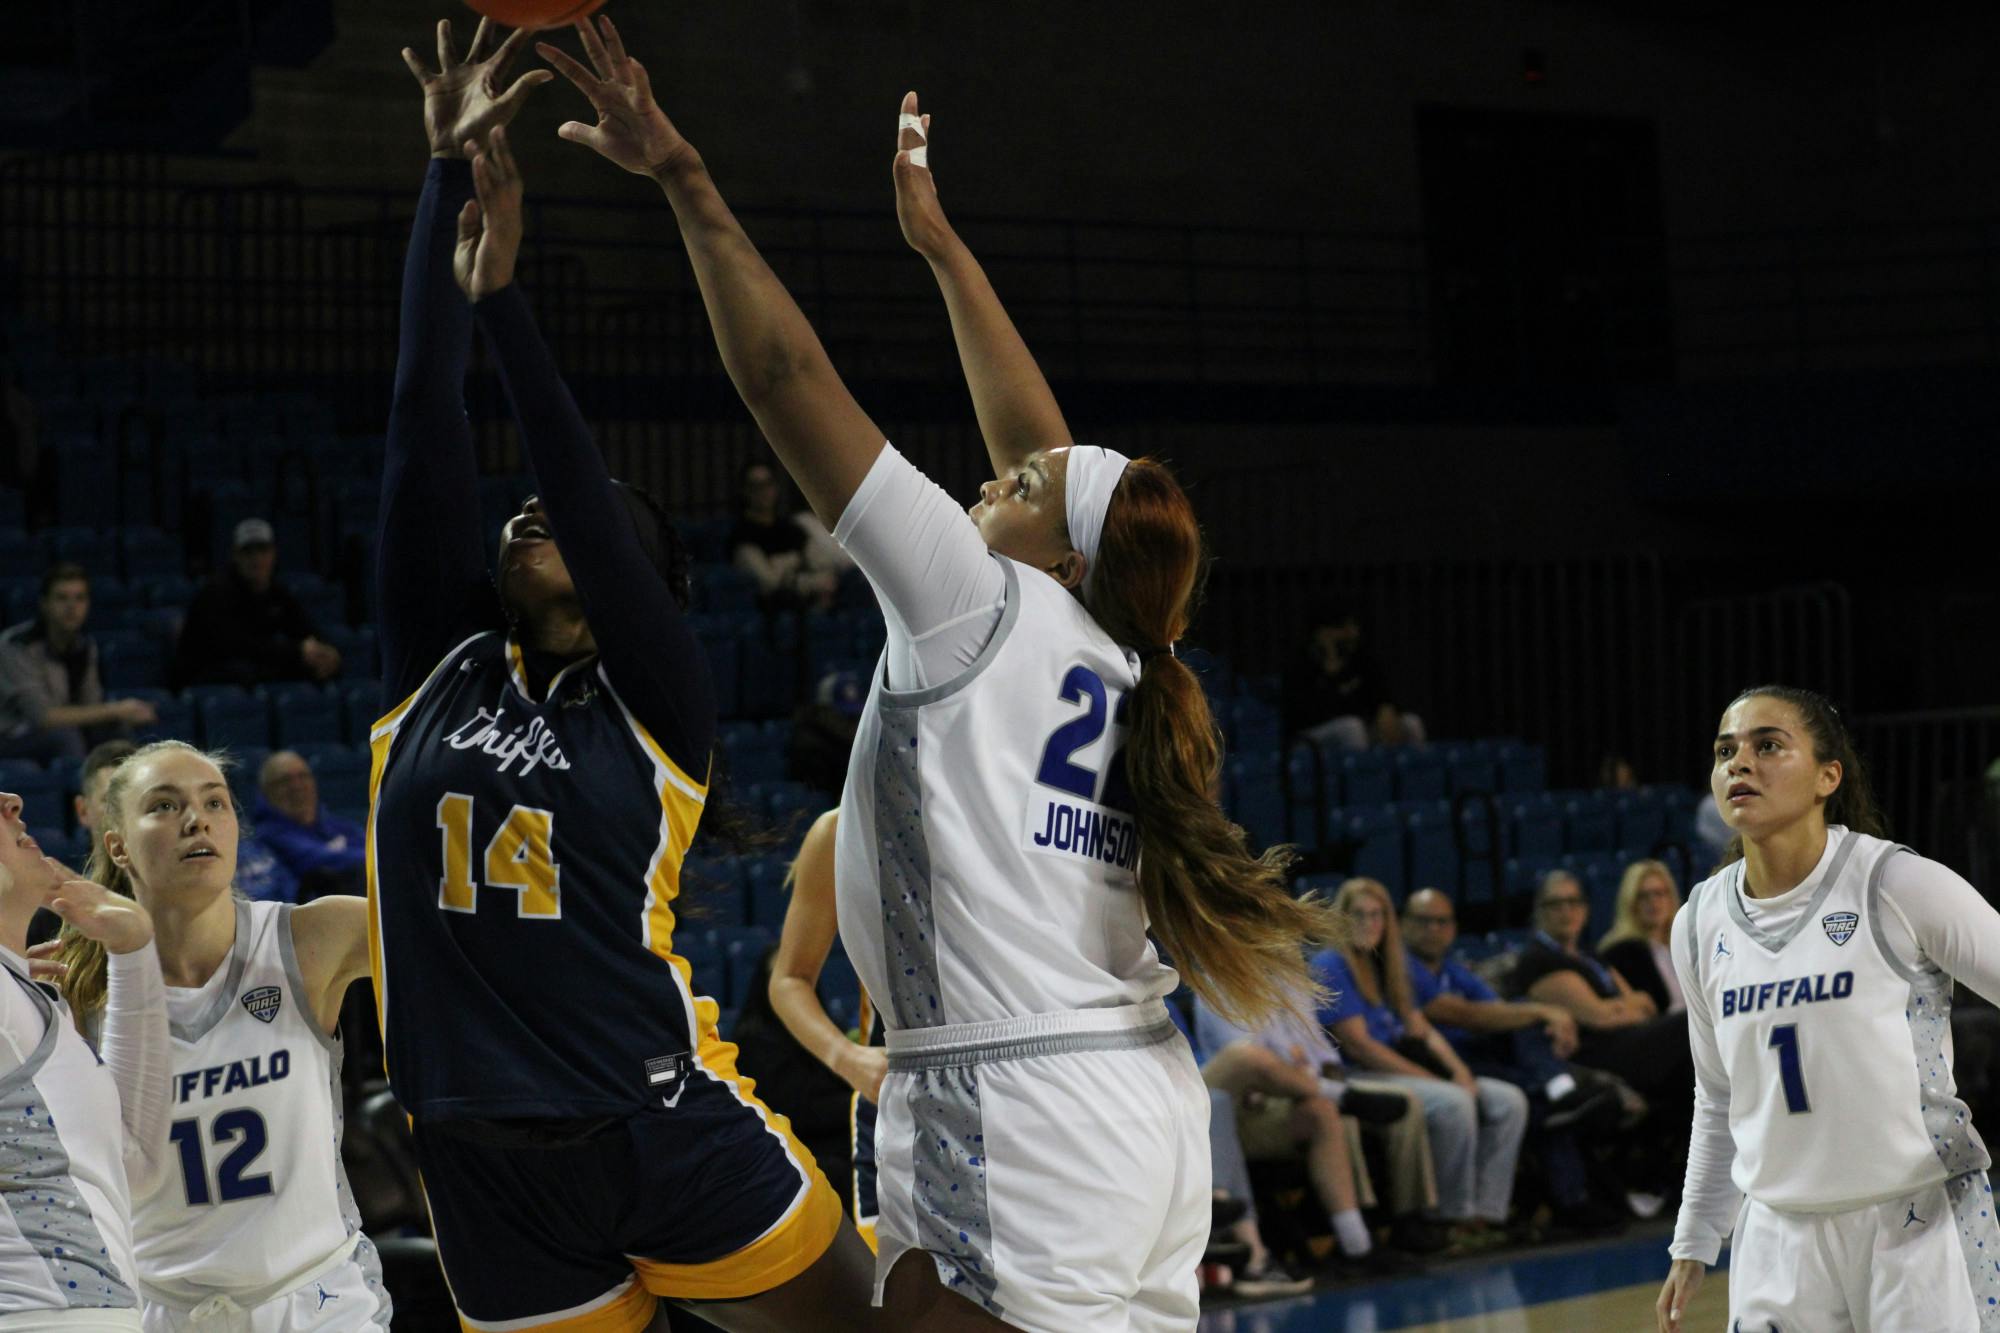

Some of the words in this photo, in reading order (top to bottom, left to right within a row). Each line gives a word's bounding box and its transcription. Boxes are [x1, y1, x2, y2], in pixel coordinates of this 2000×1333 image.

[442, 706, 571, 777] Griffs
[437, 792, 561, 919] 14
[1722, 971, 1854, 1018] BUFFALO
[172, 1049, 290, 1104] FFALO
[1768, 1023, 1812, 1114] 1
[169, 1106, 275, 1207] 12
